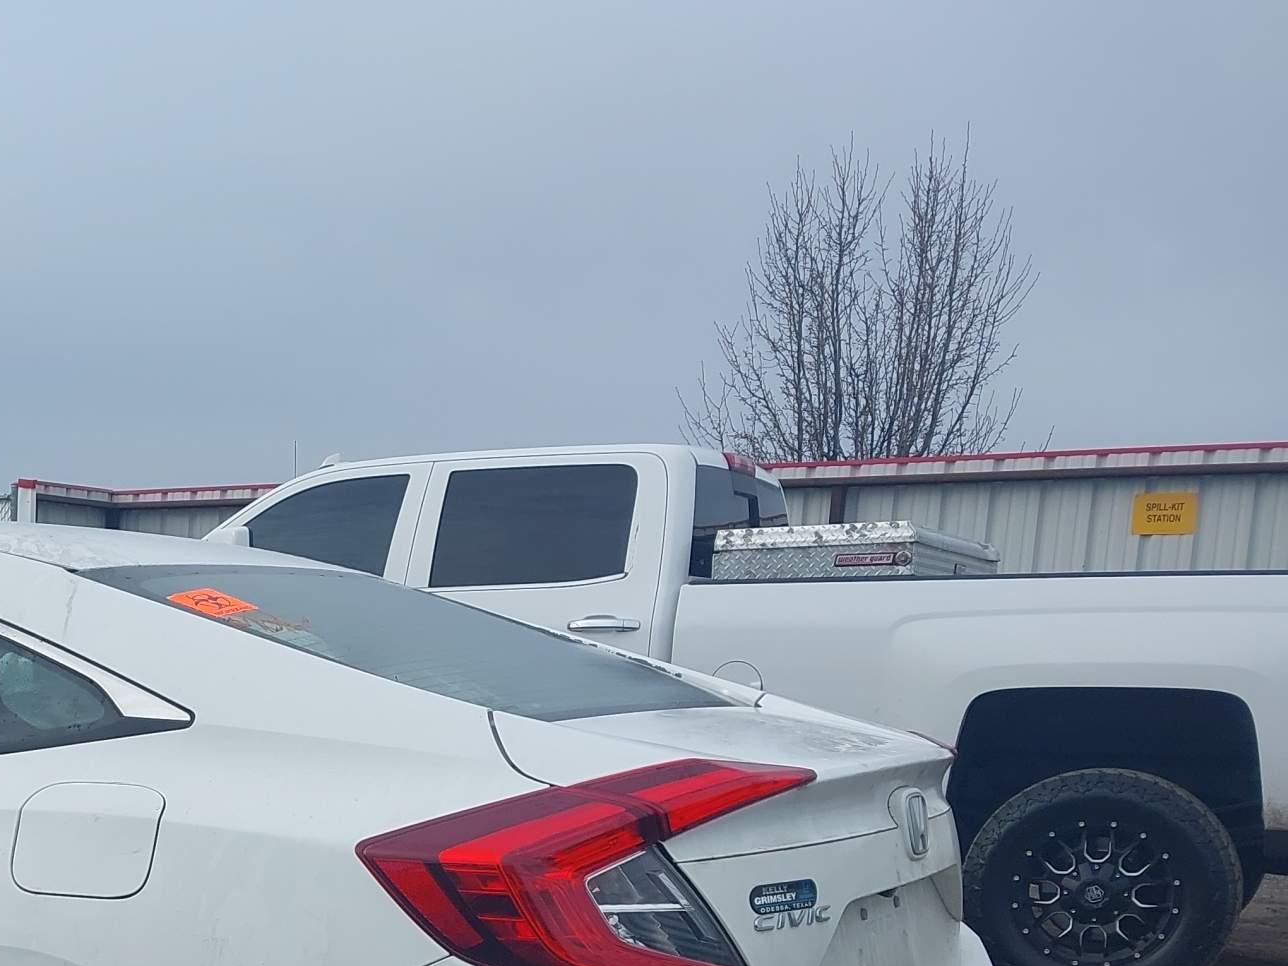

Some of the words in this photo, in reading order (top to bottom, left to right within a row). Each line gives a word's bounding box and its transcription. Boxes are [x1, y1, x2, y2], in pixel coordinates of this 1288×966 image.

[1145, 502, 1185, 512] SPILL-KIT
[1146, 513, 1182, 523] STATION
[762, 885, 788, 895] KELLY
[754, 892, 797, 905] GRIMSLEY
[792, 901, 812, 909] TEXAS
[753, 905, 831, 932] CIVIC
